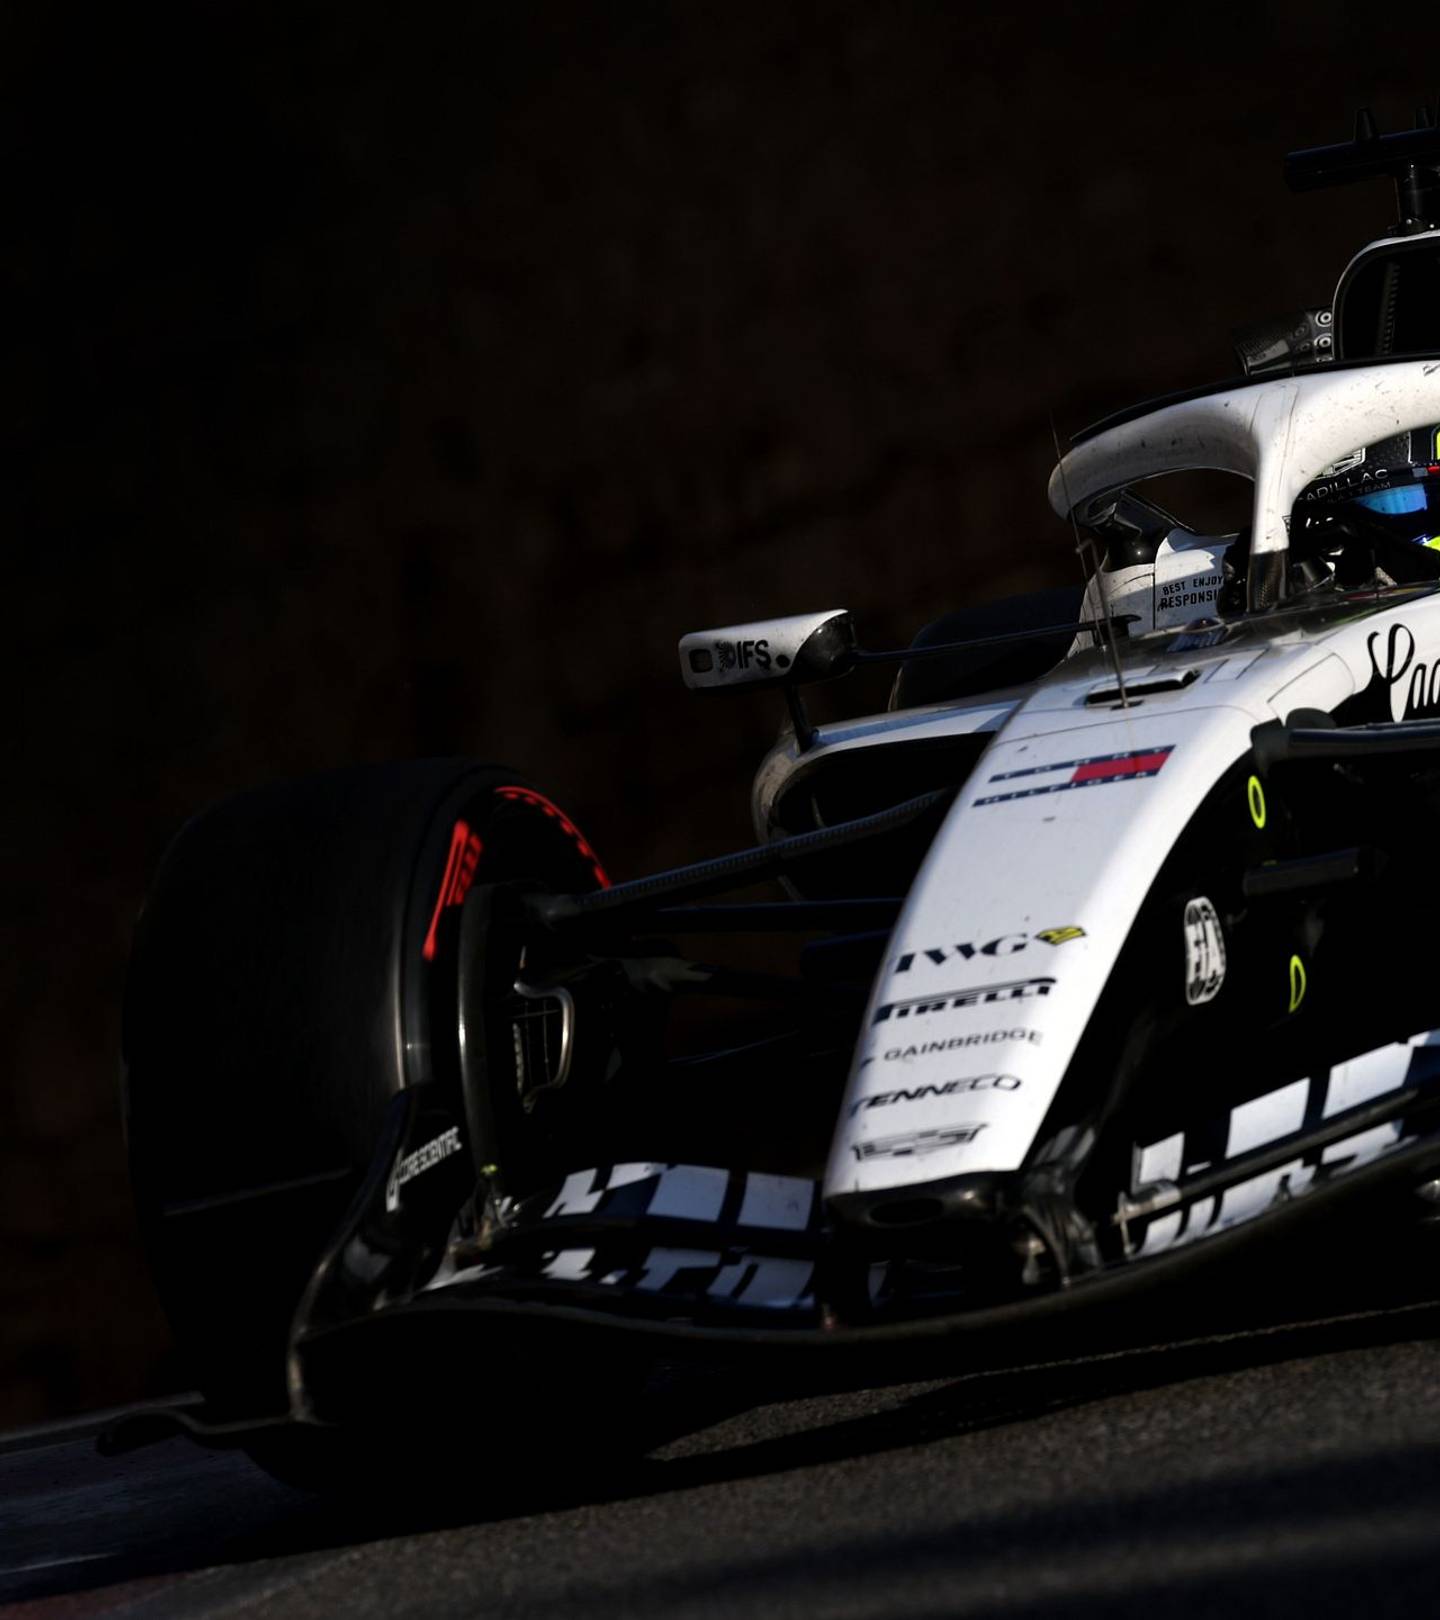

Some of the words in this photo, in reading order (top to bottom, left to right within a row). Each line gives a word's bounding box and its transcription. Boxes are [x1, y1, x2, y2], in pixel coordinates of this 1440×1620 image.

[1159, 589, 1219, 611] RESPONSI
[1162, 581, 1187, 596] BEST
[1192, 575, 1224, 589] ENJOY
[737, 639, 772, 671] IFS
[871, 976, 1057, 1028] PIRELLI
[883, 1027, 1044, 1062] GAINBRIDGE
[850, 1073, 1022, 1118] TENNECO
